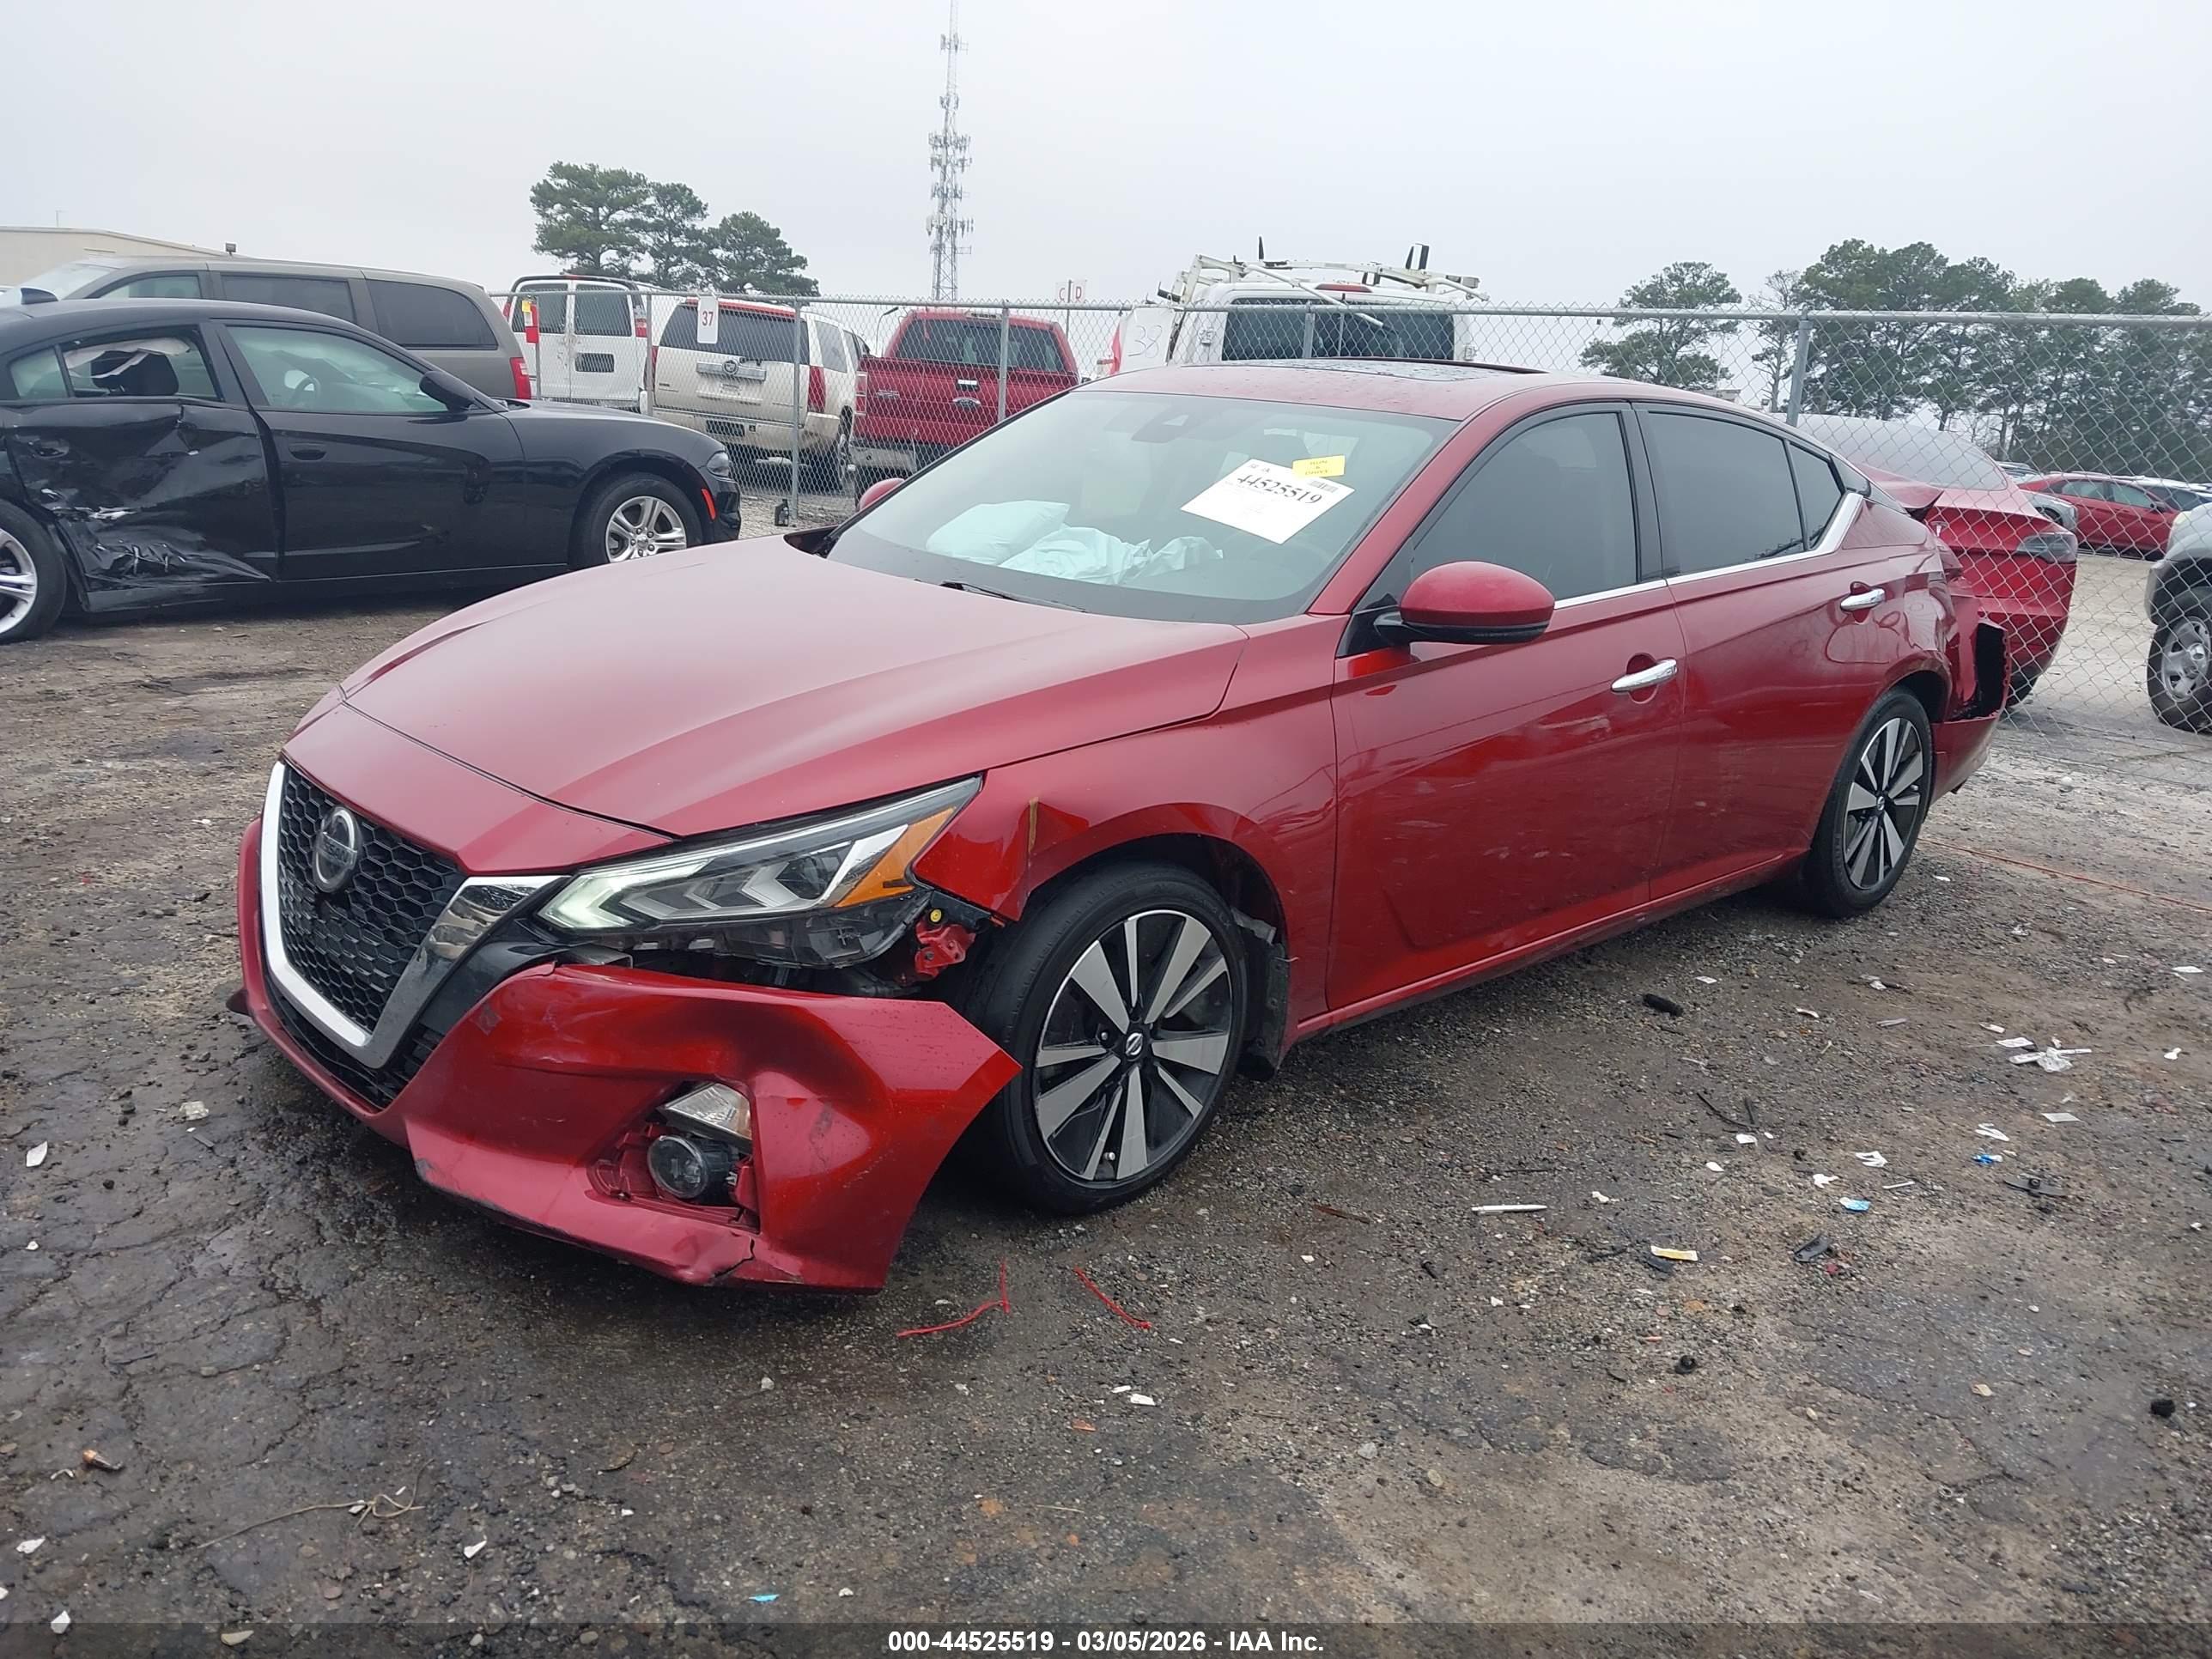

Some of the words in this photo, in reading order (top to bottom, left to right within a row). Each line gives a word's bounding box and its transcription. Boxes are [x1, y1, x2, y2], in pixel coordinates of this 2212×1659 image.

[1058, 287, 1066, 301] C
[702, 310, 714, 327] 37
[1127, 325, 1162, 358] 38
[1237, 474, 1322, 503] 44525519
